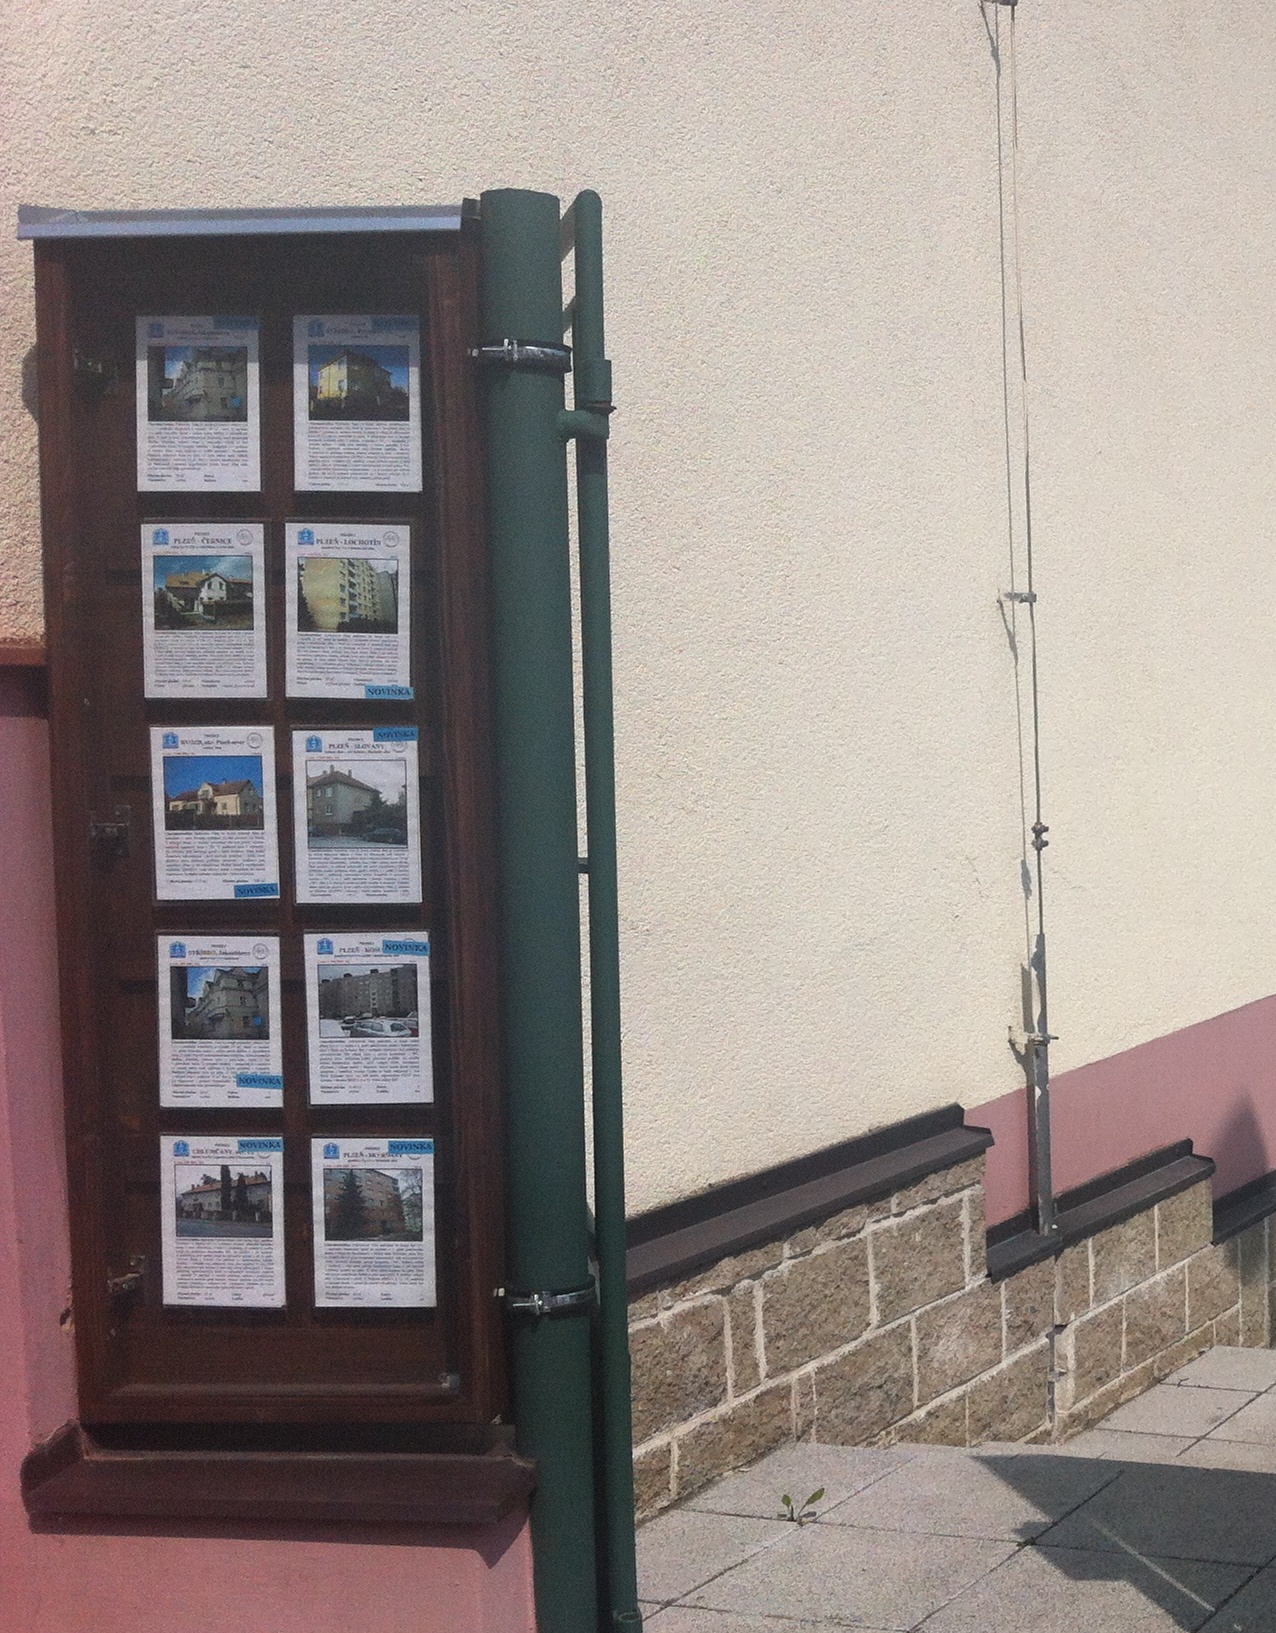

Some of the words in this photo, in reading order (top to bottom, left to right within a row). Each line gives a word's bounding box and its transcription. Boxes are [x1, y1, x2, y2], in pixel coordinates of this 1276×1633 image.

[367, 687, 411, 696] NOVINKA
[238, 885, 277, 895] NOVINKA
[384, 943, 428, 953] NOVINKA
[240, 1076, 281, 1086] NOVINKA
[240, 1141, 282, 1150] NOVINKA
[391, 1141, 432, 1151] NOVINKA
